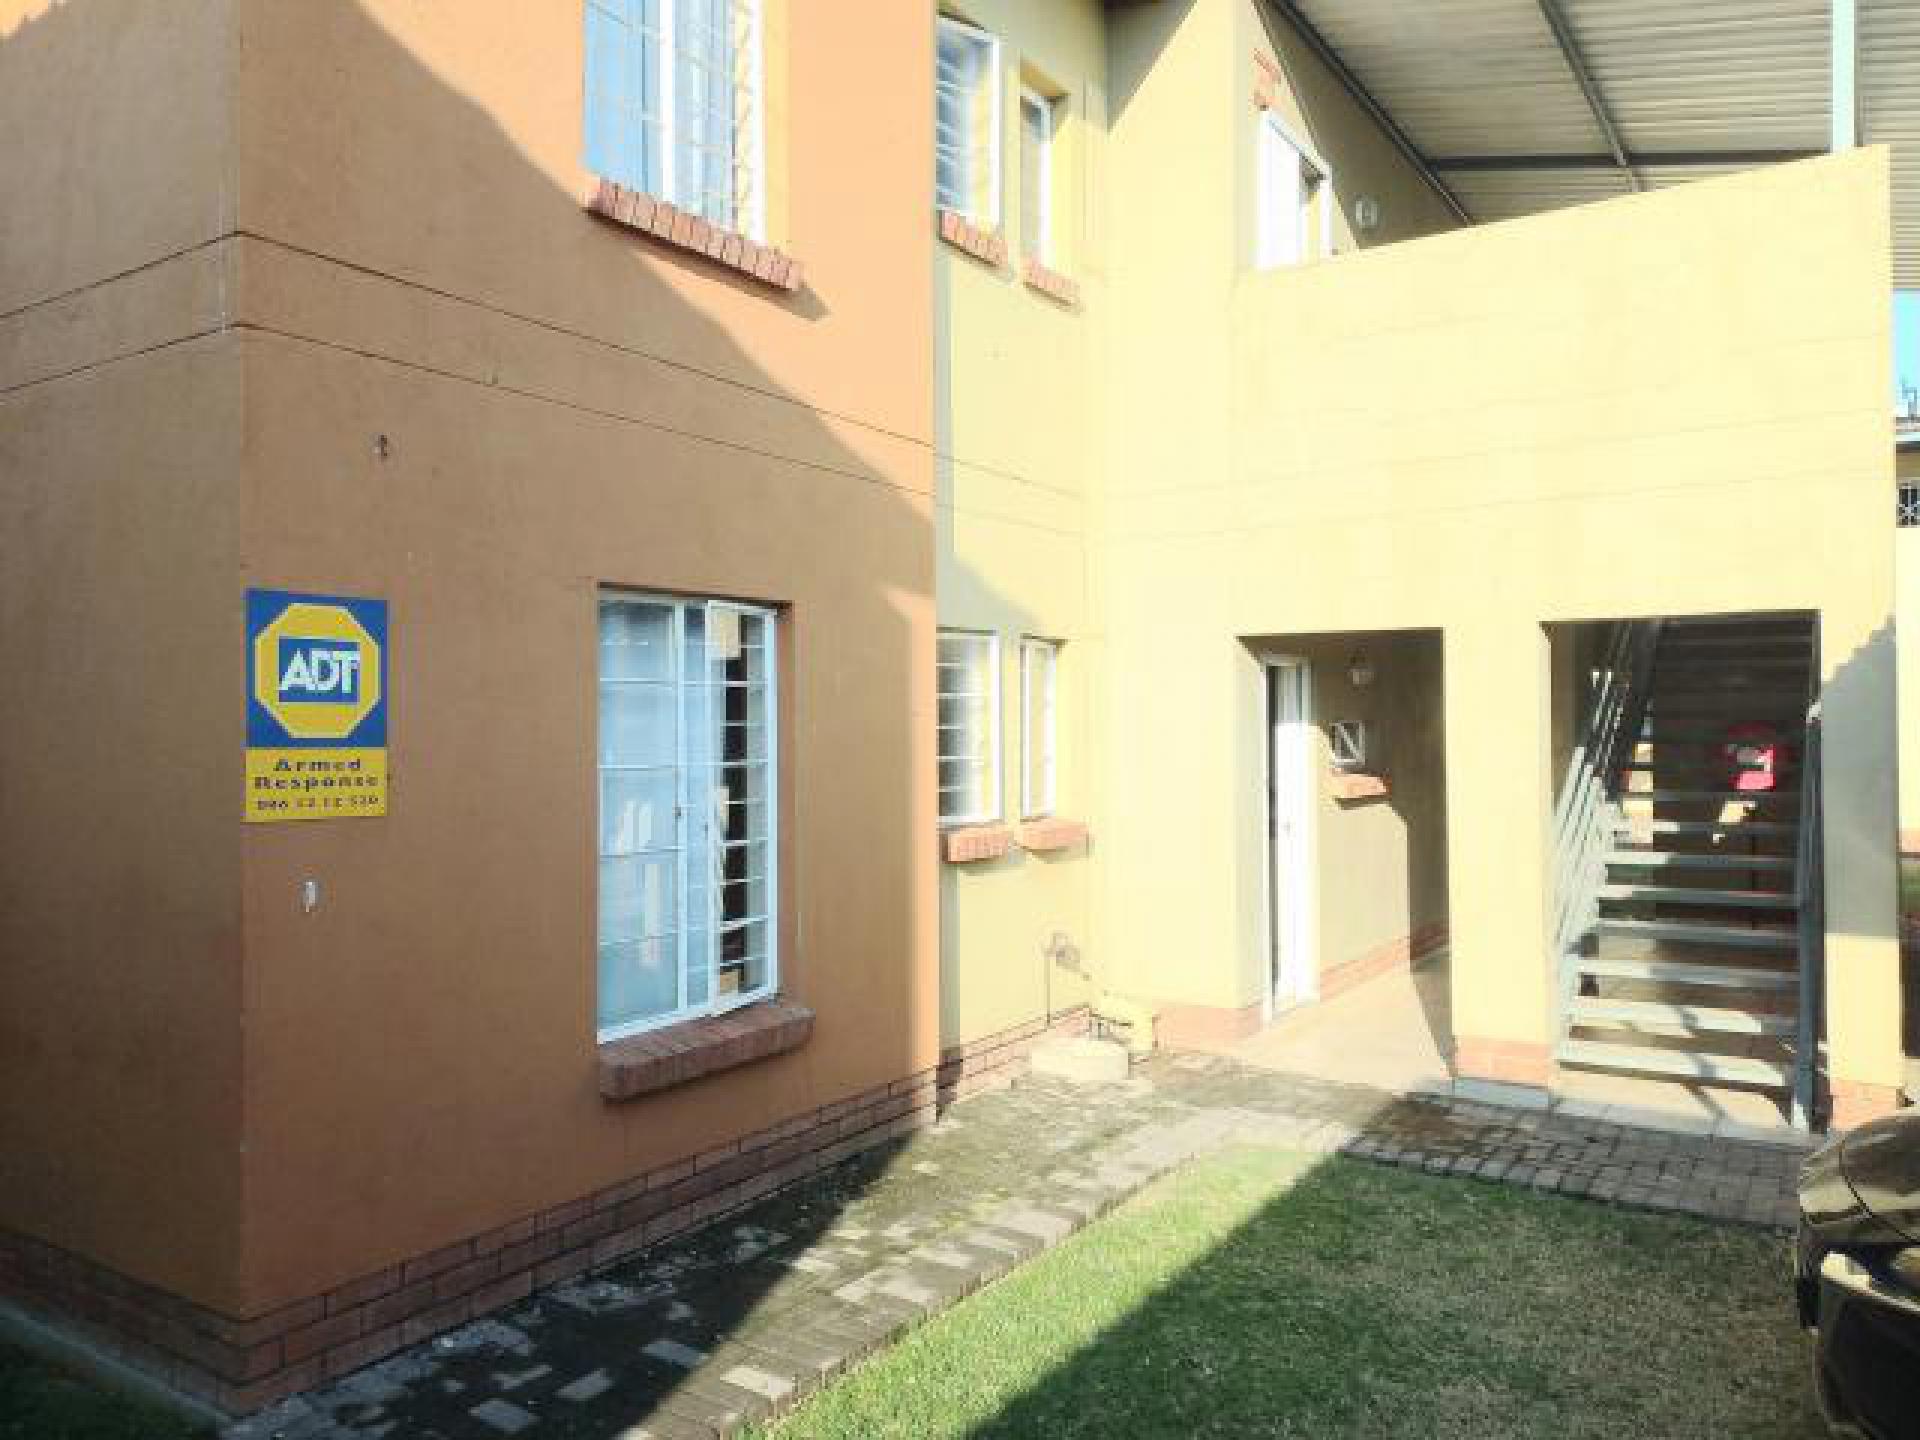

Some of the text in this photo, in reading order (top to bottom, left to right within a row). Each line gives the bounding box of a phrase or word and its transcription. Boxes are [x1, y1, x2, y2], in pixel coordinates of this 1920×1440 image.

[279, 649, 360, 694] ADT
[273, 758, 360, 771] Armed
[254, 776, 378, 792] Response
